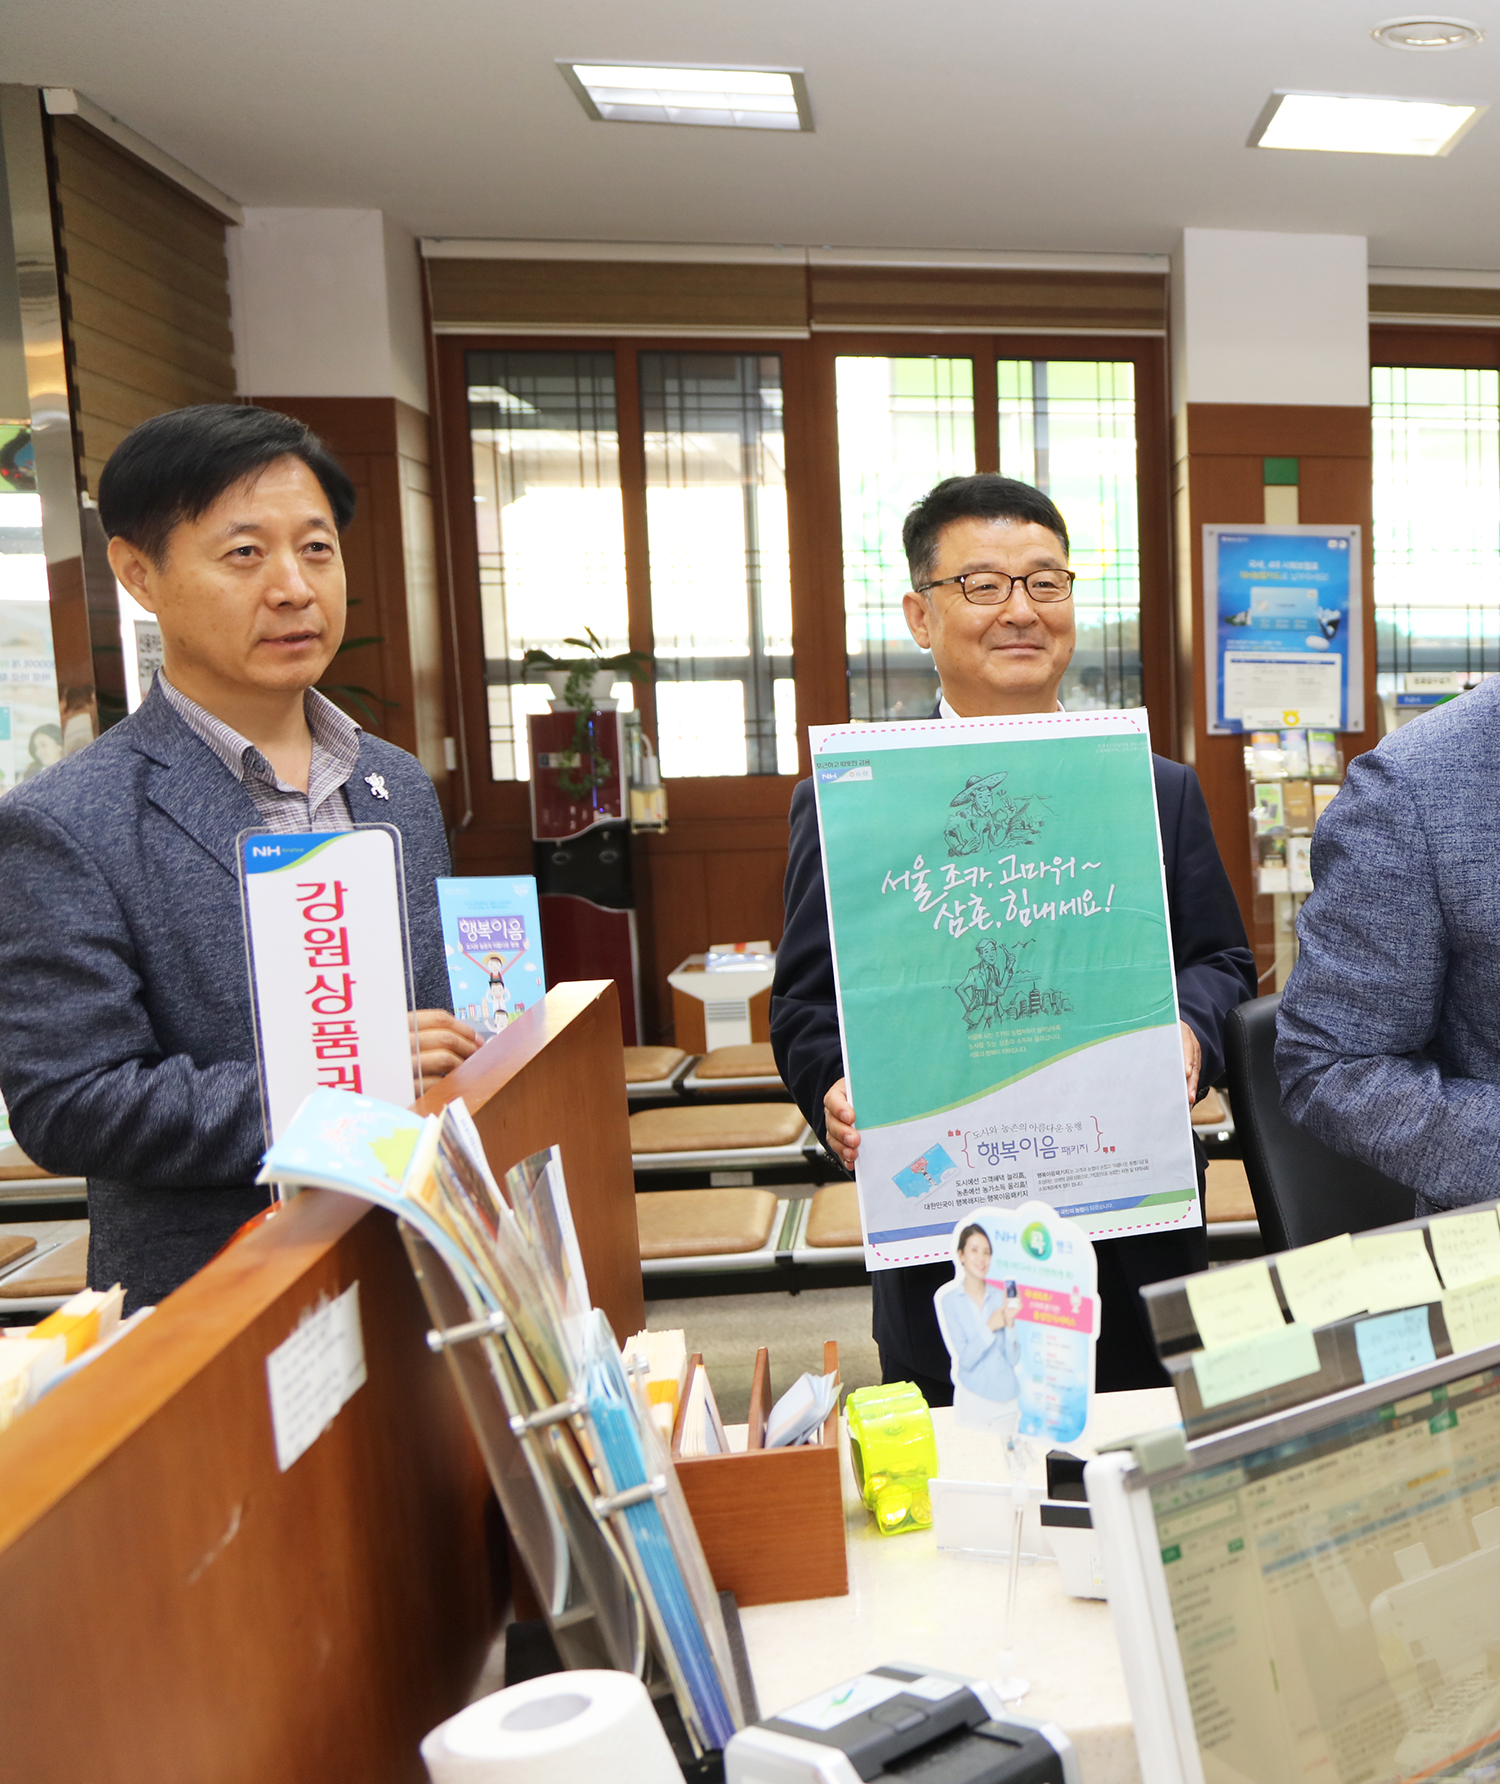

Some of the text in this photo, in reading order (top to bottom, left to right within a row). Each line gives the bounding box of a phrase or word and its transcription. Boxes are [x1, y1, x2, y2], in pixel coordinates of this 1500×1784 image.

[252, 846, 281, 857] NH
[881, 854, 949, 912] 서울
[940, 863, 993, 890] 조카,
[933, 883, 1115, 939] 삼촌, 힘내세요!
[459, 918, 524, 942] 행복이음
[972, 1121, 1083, 1140] 도시와 농촌의 아름다운 동행
[977, 1135, 1089, 1166] 행복이음 패키지
[956, 1177, 980, 1187] 도시에선
[981, 1175, 1005, 1184] 고객혜택
[957, 1187, 980, 1197] 농촌에선
[982, 1184, 1006, 1194] 농가소득
[924, 1190, 1028, 1210] 대한민국이 행복해지는 행복이음패키지
[1060, 1207, 1074, 1215] 국민의
[1075, 1205, 1089, 1213] 농협이
[995, 1230, 1017, 1244] NH
